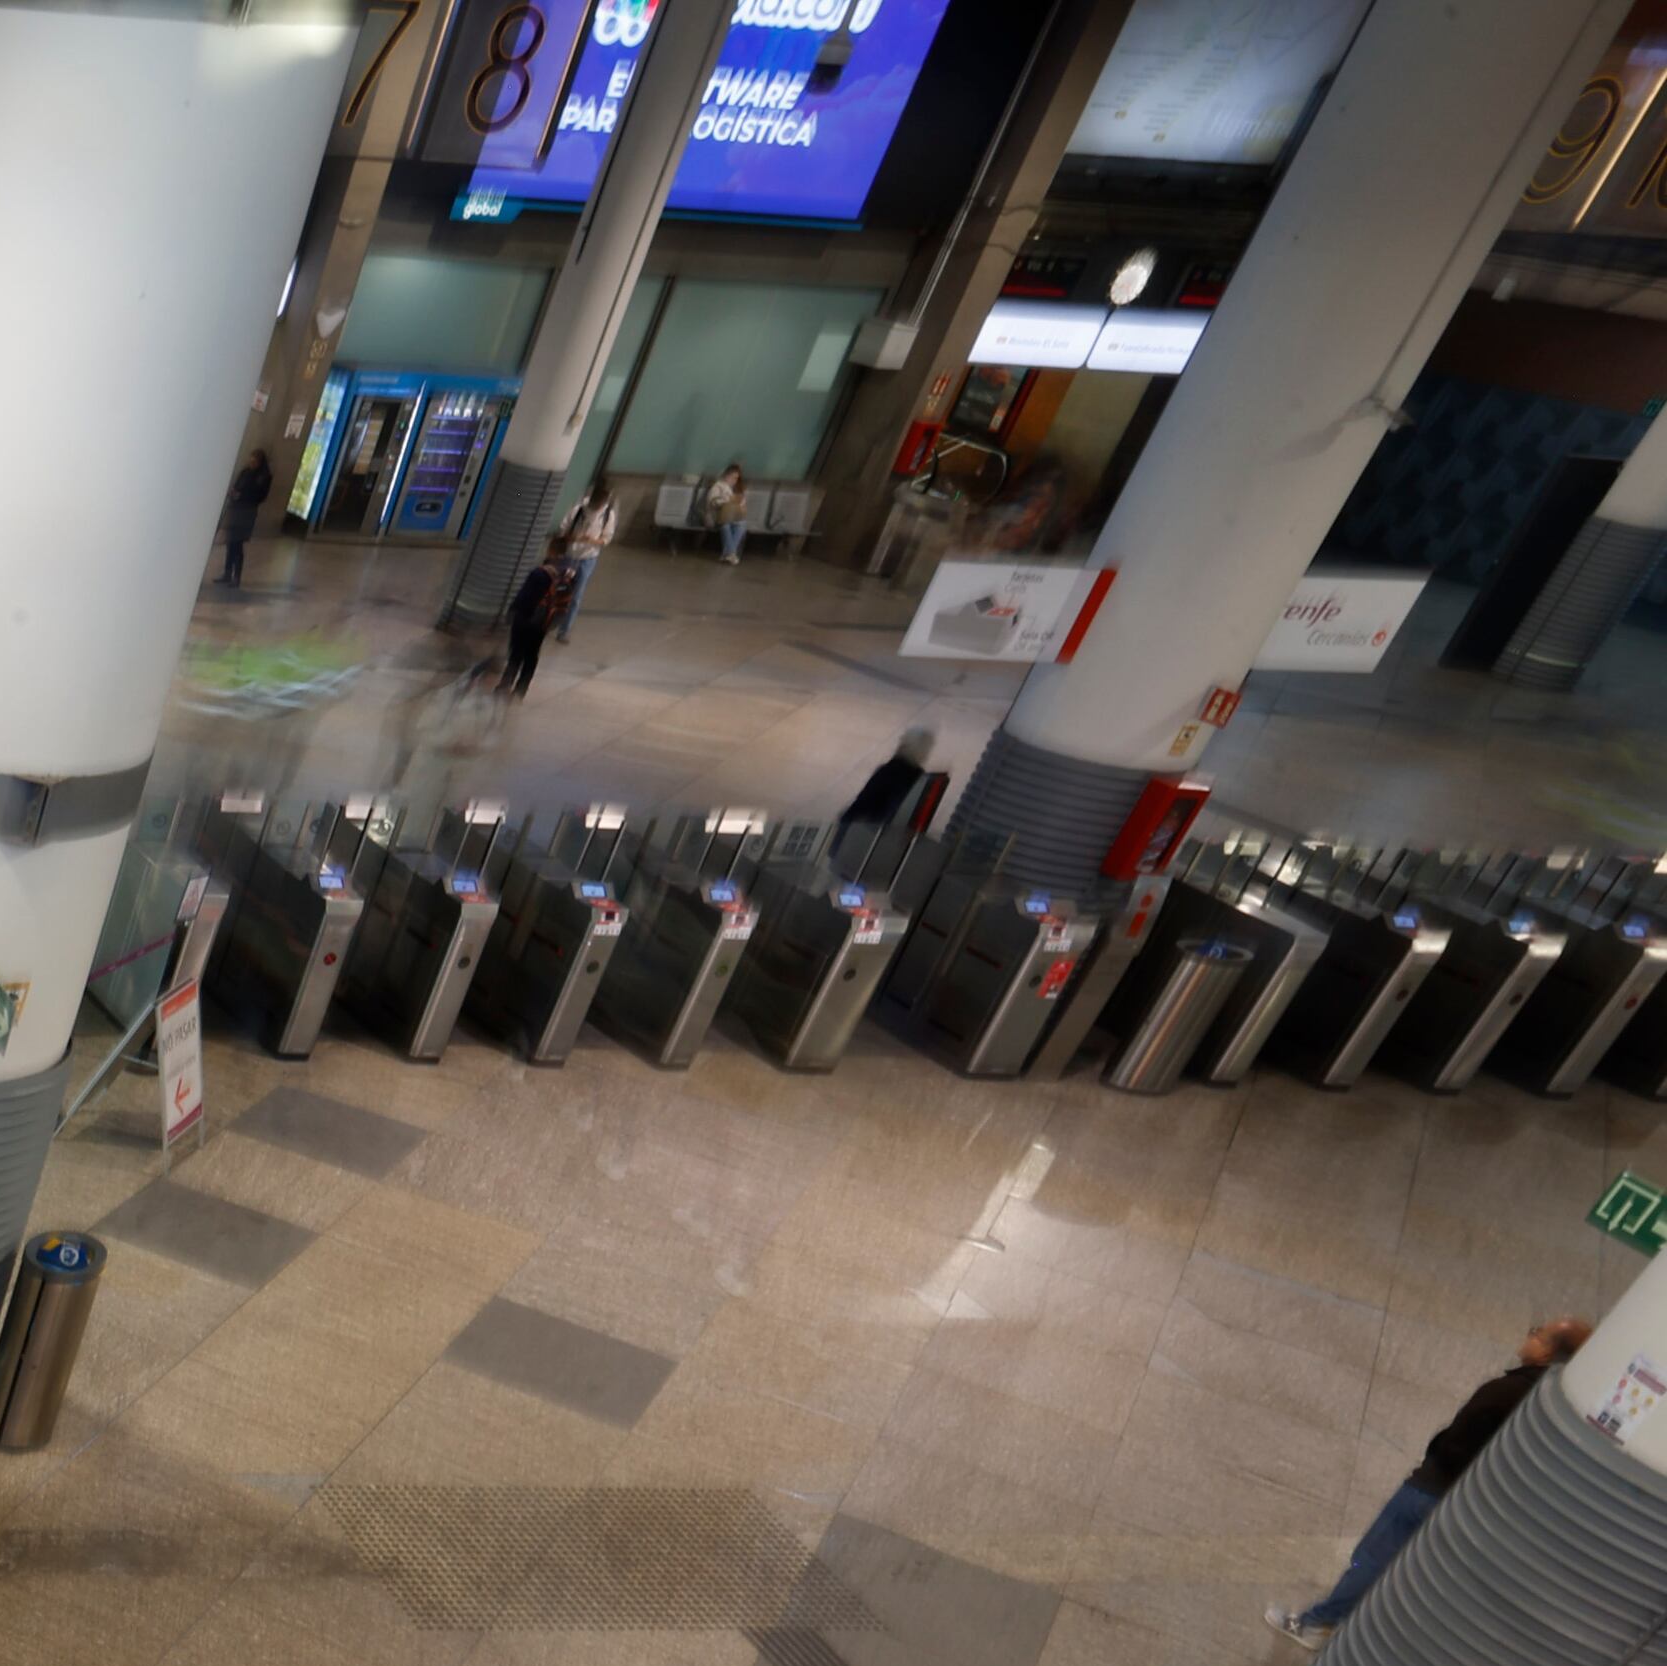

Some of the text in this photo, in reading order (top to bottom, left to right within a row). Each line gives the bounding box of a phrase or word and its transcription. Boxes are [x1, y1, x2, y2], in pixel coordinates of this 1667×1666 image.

[343, 0, 420, 127] 7
[464, 4, 545, 134] 8
[702, 79, 804, 110] TWARE
[557, 107, 815, 147] PAR OGÍSTICA
[463, 201, 503, 220] global
[1282, 598, 1342, 629] enfe
